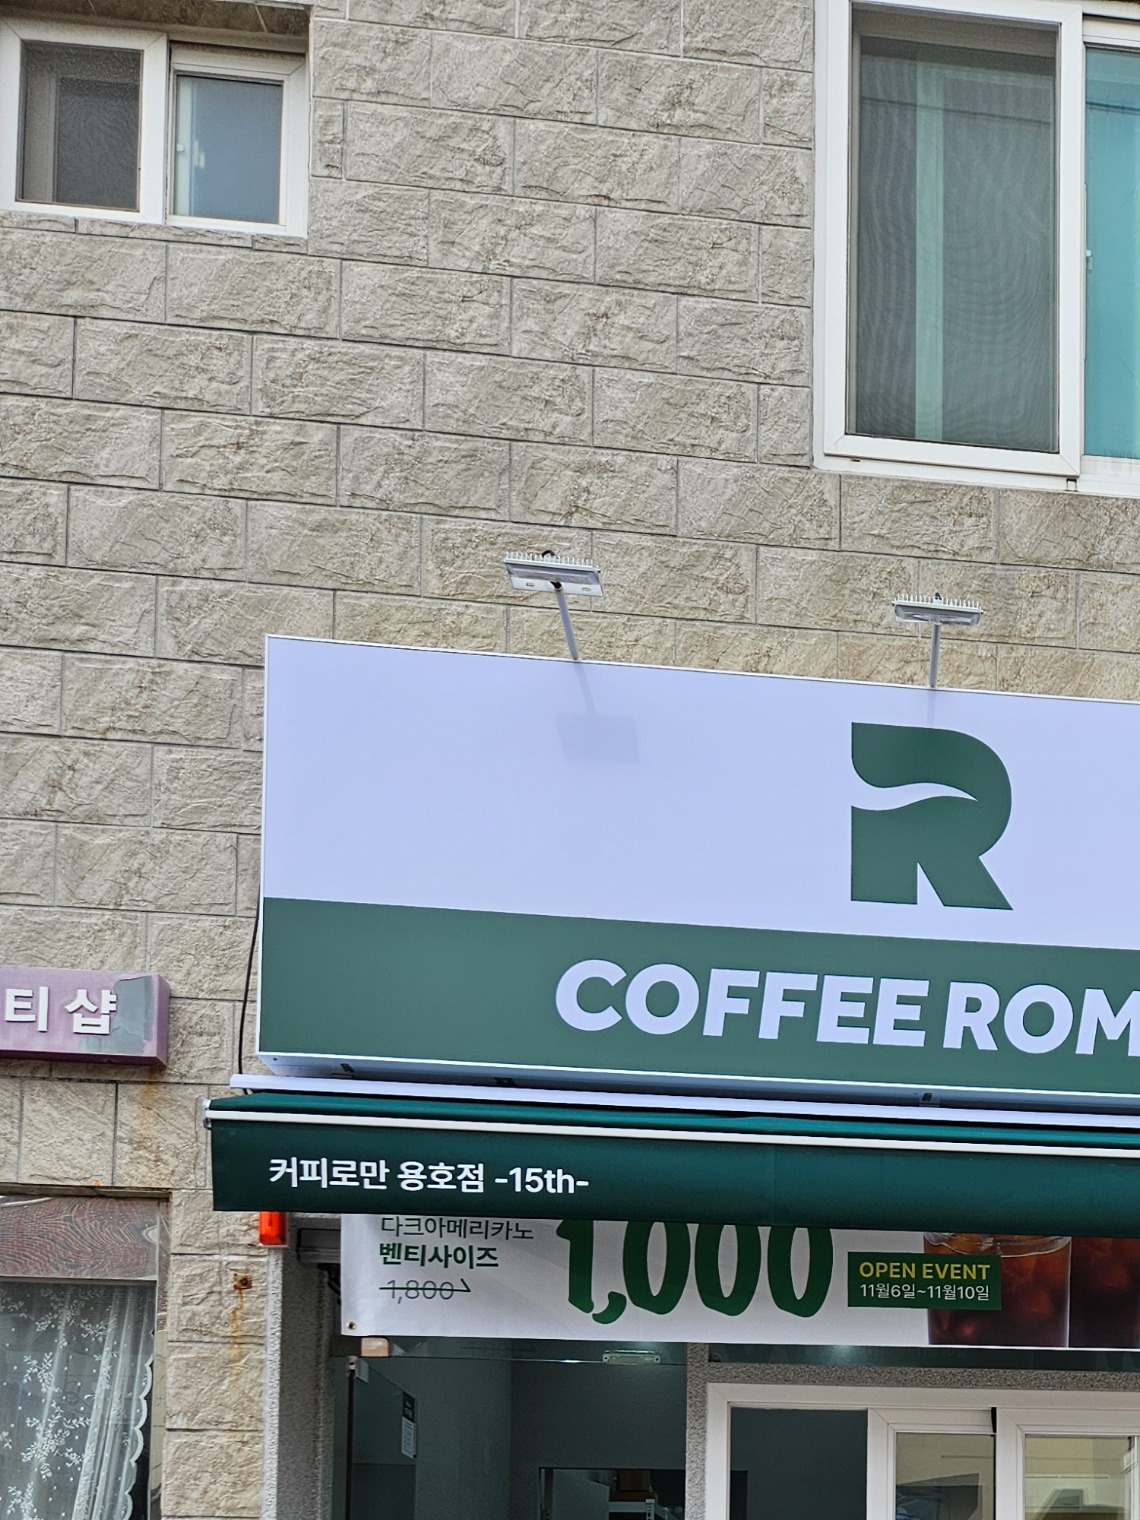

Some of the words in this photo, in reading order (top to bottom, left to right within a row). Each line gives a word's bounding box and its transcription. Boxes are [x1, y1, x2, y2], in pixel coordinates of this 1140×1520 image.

[851, 722, 1013, 911] R
[556, 959, 929, 1050] COFFEE
[268, 1157, 389, 1191] 커피로만
[397, 1161, 486, 1194] 용호점
[494, 1165, 589, 1196] -15th-
[381, 1216, 534, 1241] 다크아메리카노
[379, 1242, 499, 1269] 벤티사이즈
[556, 1219, 833, 1324] 1,000
[859, 1261, 916, 1279] OPEN
[922, 1263, 991, 1280] EVENT
[386, 1278, 456, 1304] 1,800
[860, 1282, 989, 1301] 11월6일~11월10일
